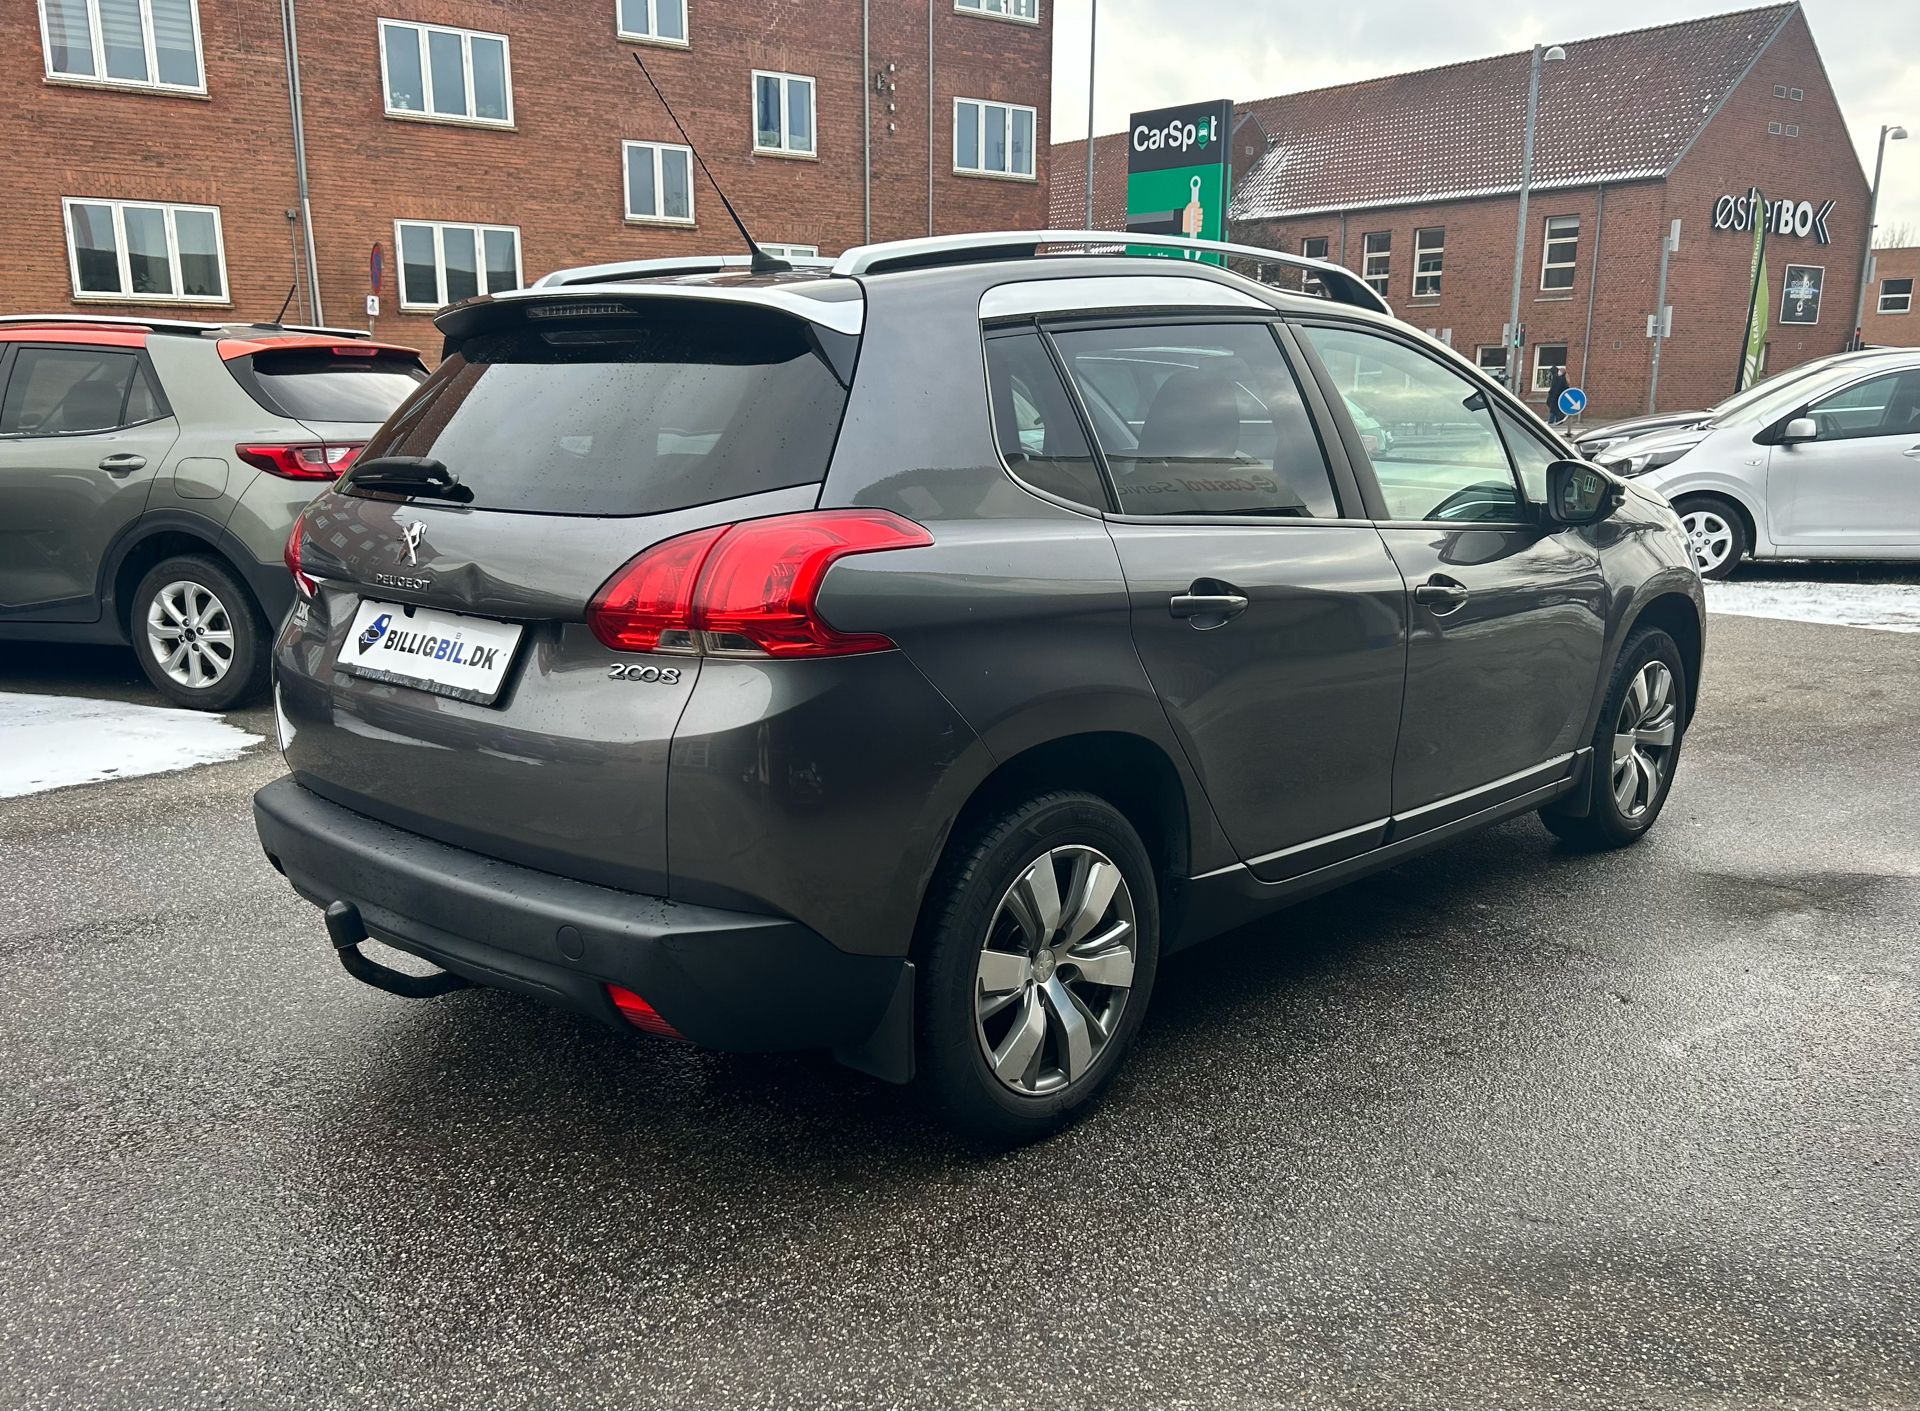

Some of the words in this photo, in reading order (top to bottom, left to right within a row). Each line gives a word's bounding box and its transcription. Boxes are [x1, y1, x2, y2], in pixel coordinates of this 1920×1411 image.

[375, 573, 431, 592] PEUGEOT
[296, 600, 311, 621] DK
[383, 629, 500, 671] BILLIGBIL.DK
[608, 663, 680, 685] 2008
